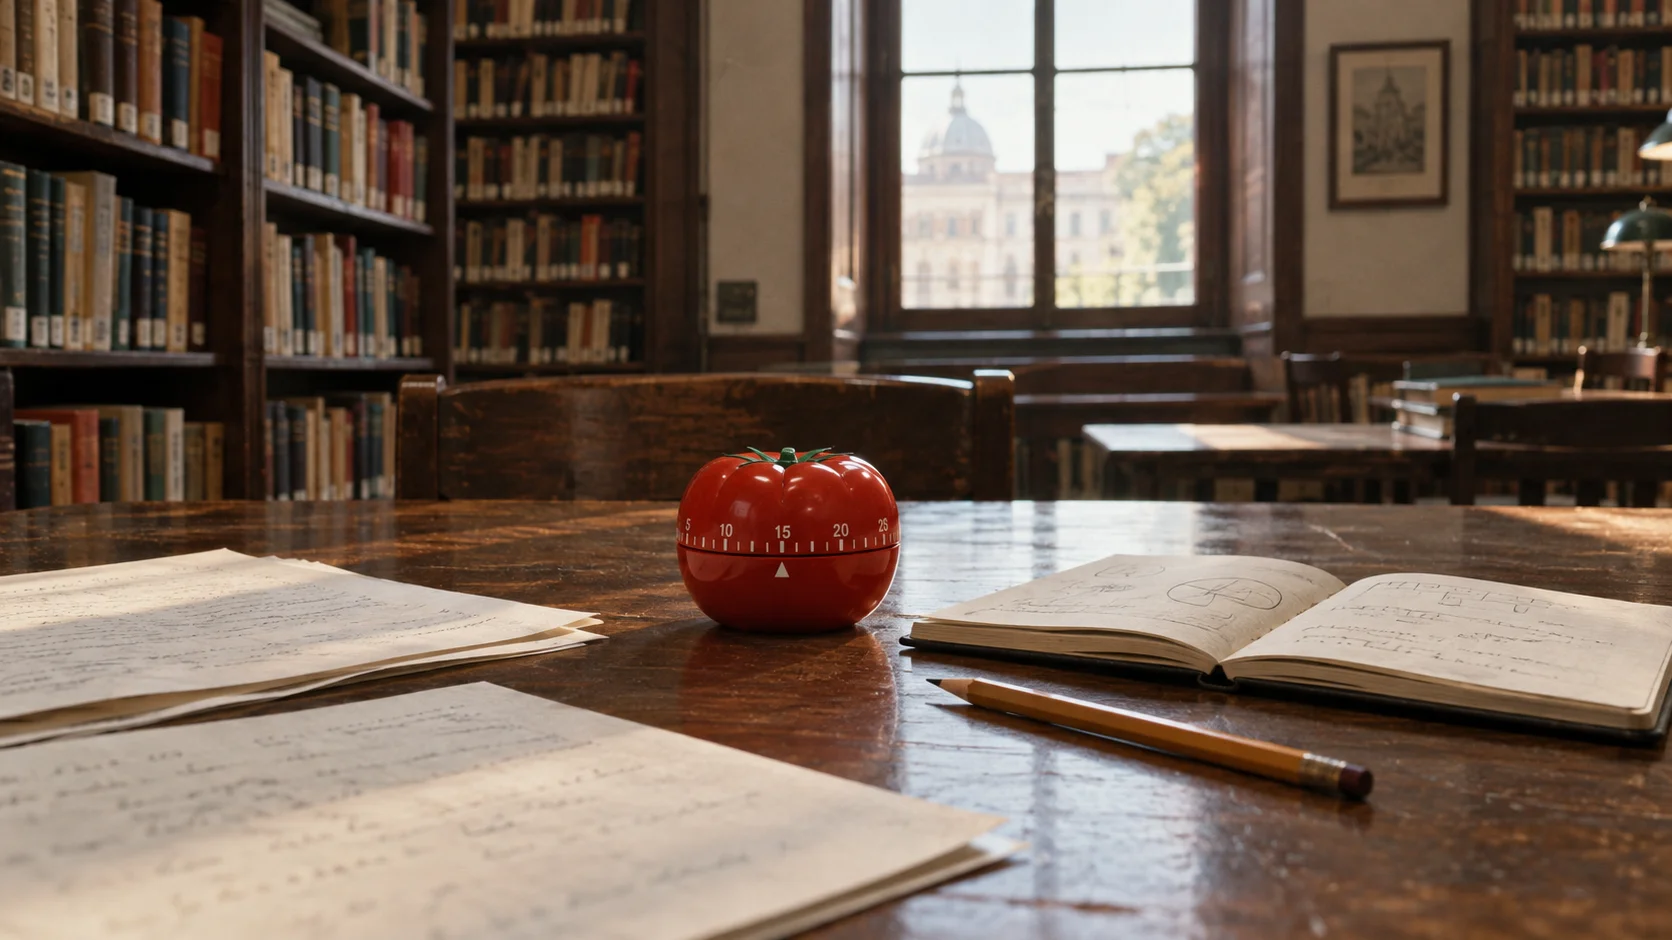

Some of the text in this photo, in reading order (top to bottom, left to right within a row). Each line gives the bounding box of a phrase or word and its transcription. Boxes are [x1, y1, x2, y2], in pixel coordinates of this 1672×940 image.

[685, 517, 691, 531] 5
[719, 523, 733, 537] 10
[775, 525, 791, 539] 15
[833, 523, 849, 537] 20
